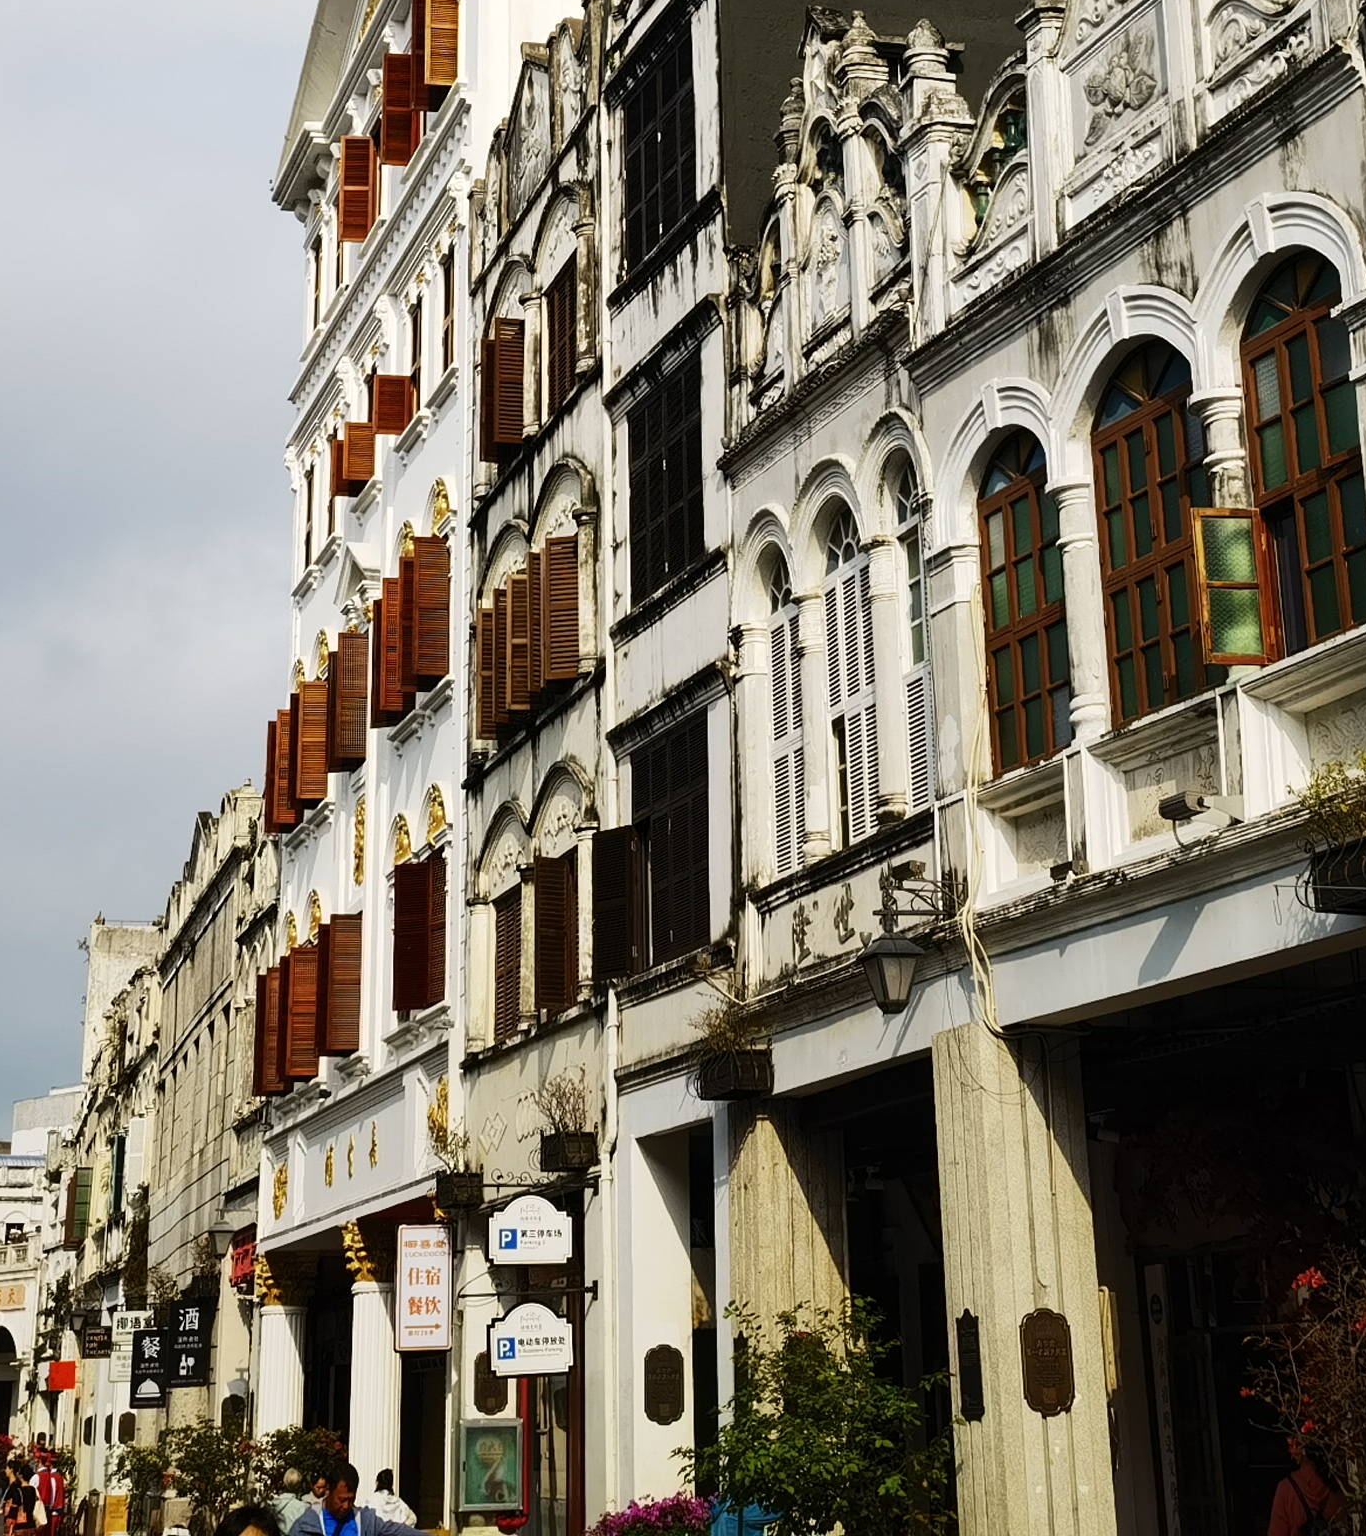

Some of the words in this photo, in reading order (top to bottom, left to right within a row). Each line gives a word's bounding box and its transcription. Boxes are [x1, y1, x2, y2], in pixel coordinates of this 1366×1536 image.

[520, 1229, 563, 1238] 第三停车场
[407, 1266, 442, 1287] 住宿
[407, 1296, 442, 1316] 餐饮
[178, 1307, 200, 1332] 酒
[141, 1336, 161, 1360] 餐
[517, 1335, 566, 1347] 电动车停放处
